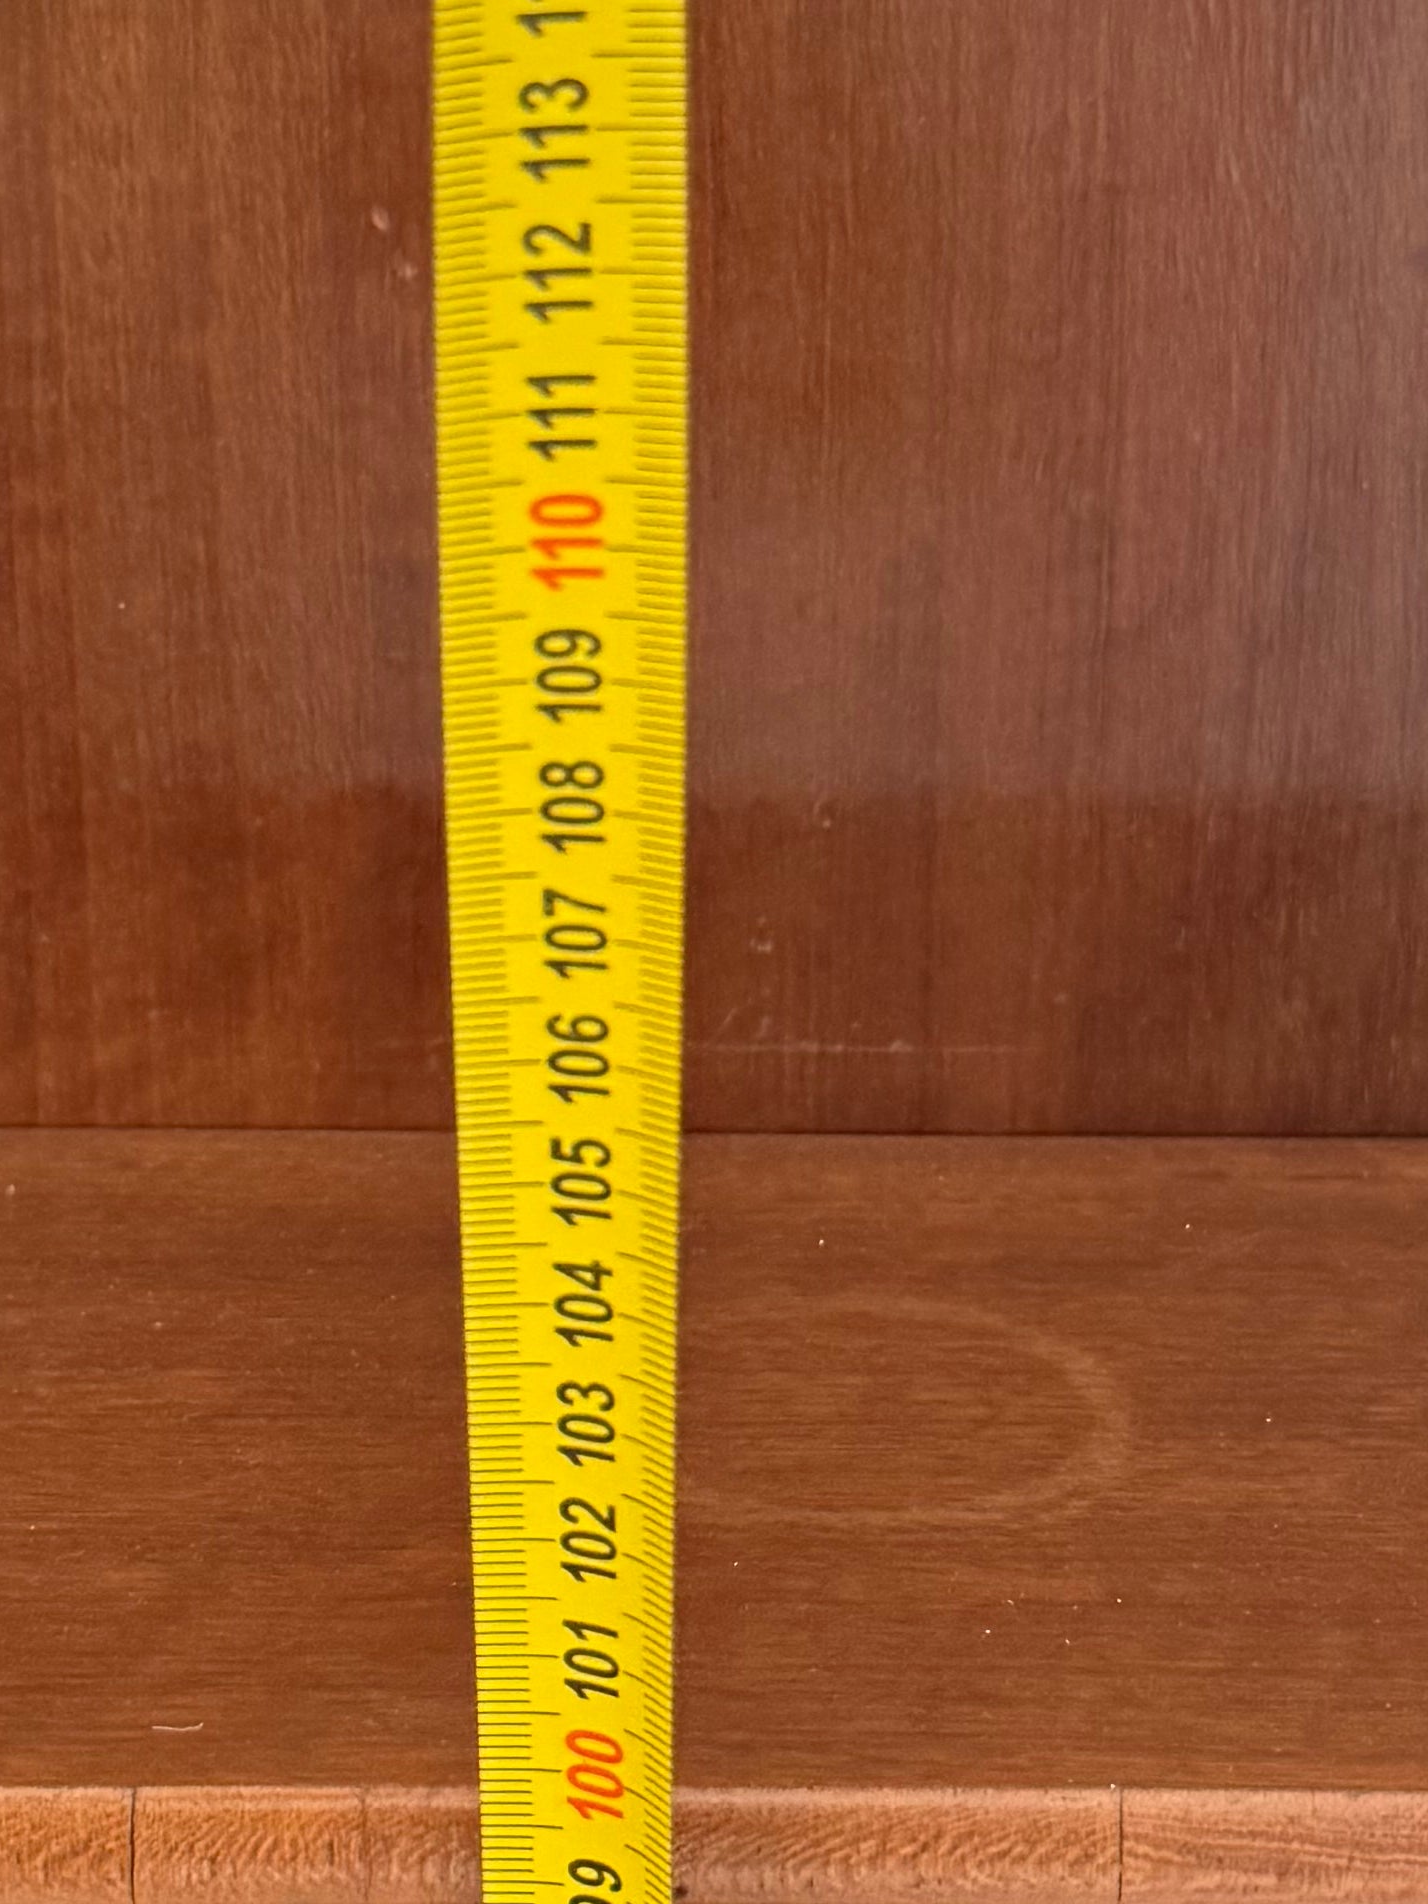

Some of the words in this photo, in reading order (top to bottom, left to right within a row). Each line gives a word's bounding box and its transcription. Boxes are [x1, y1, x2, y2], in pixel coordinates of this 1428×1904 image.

[517, 77, 591, 183] 113
[521, 221, 594, 324] 112
[525, 373, 598, 461] 111
[528, 492, 605, 591] 110
[533, 628, 604, 724] 109
[537, 760, 606, 854] 108
[541, 888, 609, 980] 107
[545, 1014, 611, 1104] 106
[549, 1137, 613, 1227] 105
[552, 1260, 614, 1348] 104
[555, 1381, 616, 1467] 103
[558, 1497, 618, 1583] 102
[562, 1619, 620, 1700] 101
[564, 1729, 626, 1820] 100
